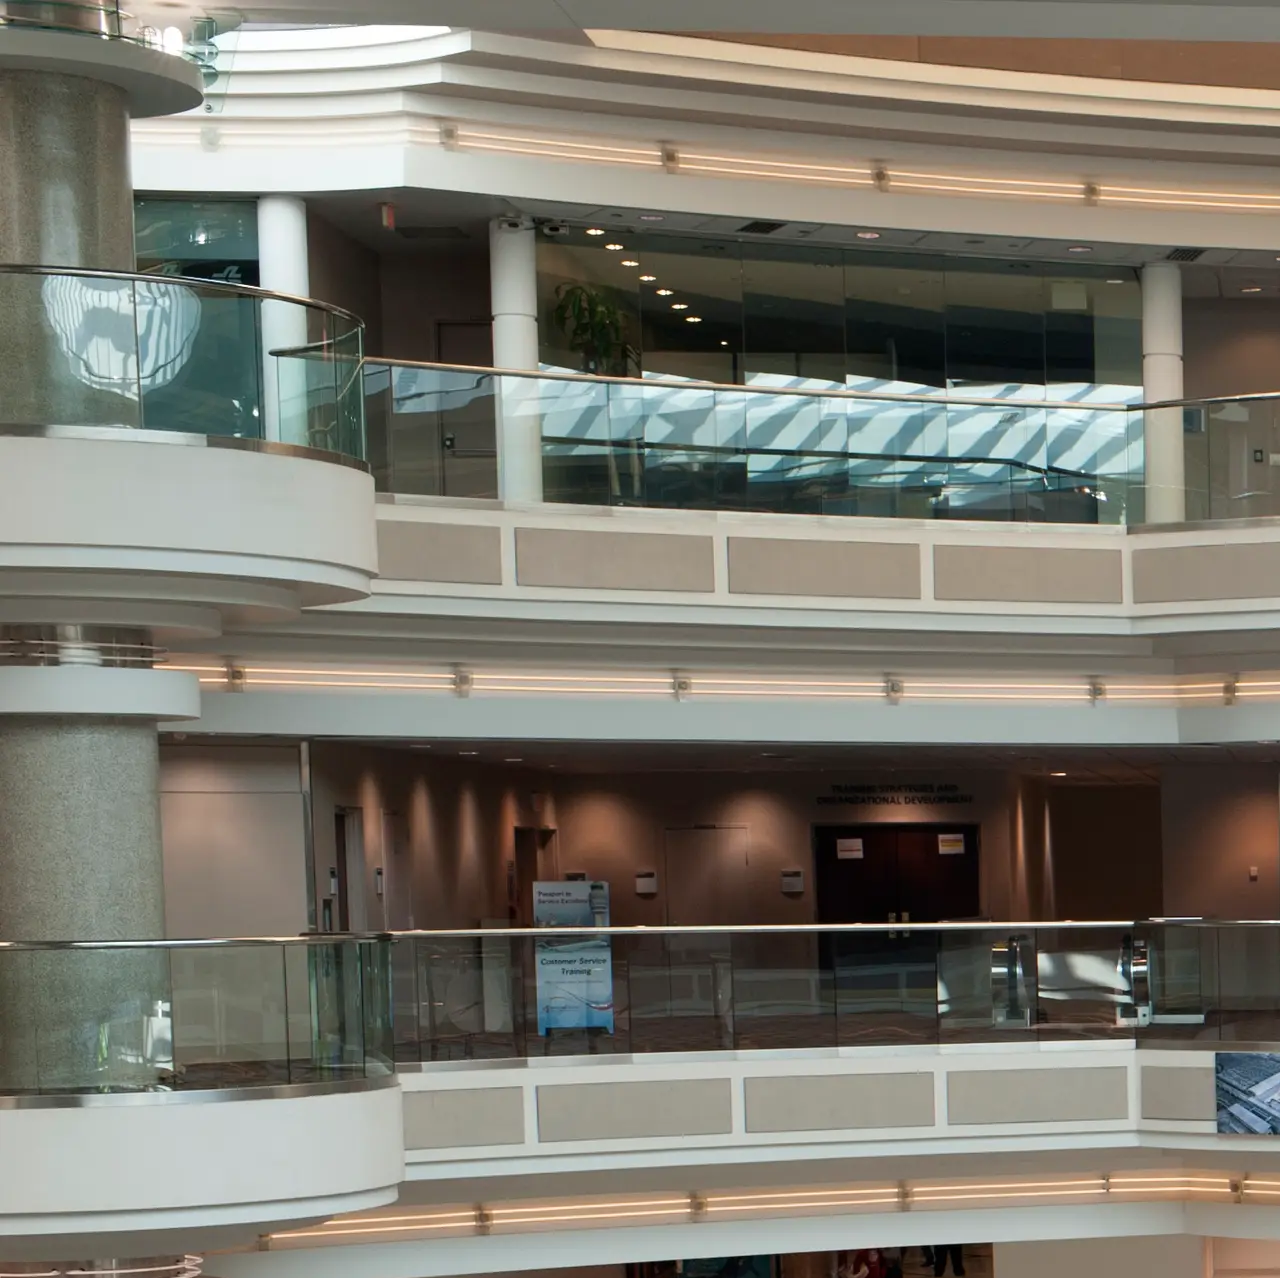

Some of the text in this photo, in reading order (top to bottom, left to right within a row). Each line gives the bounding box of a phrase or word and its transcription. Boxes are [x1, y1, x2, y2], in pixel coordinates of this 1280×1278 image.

[541, 957, 607, 966] Customer Service
[561, 968, 592, 976] Training
